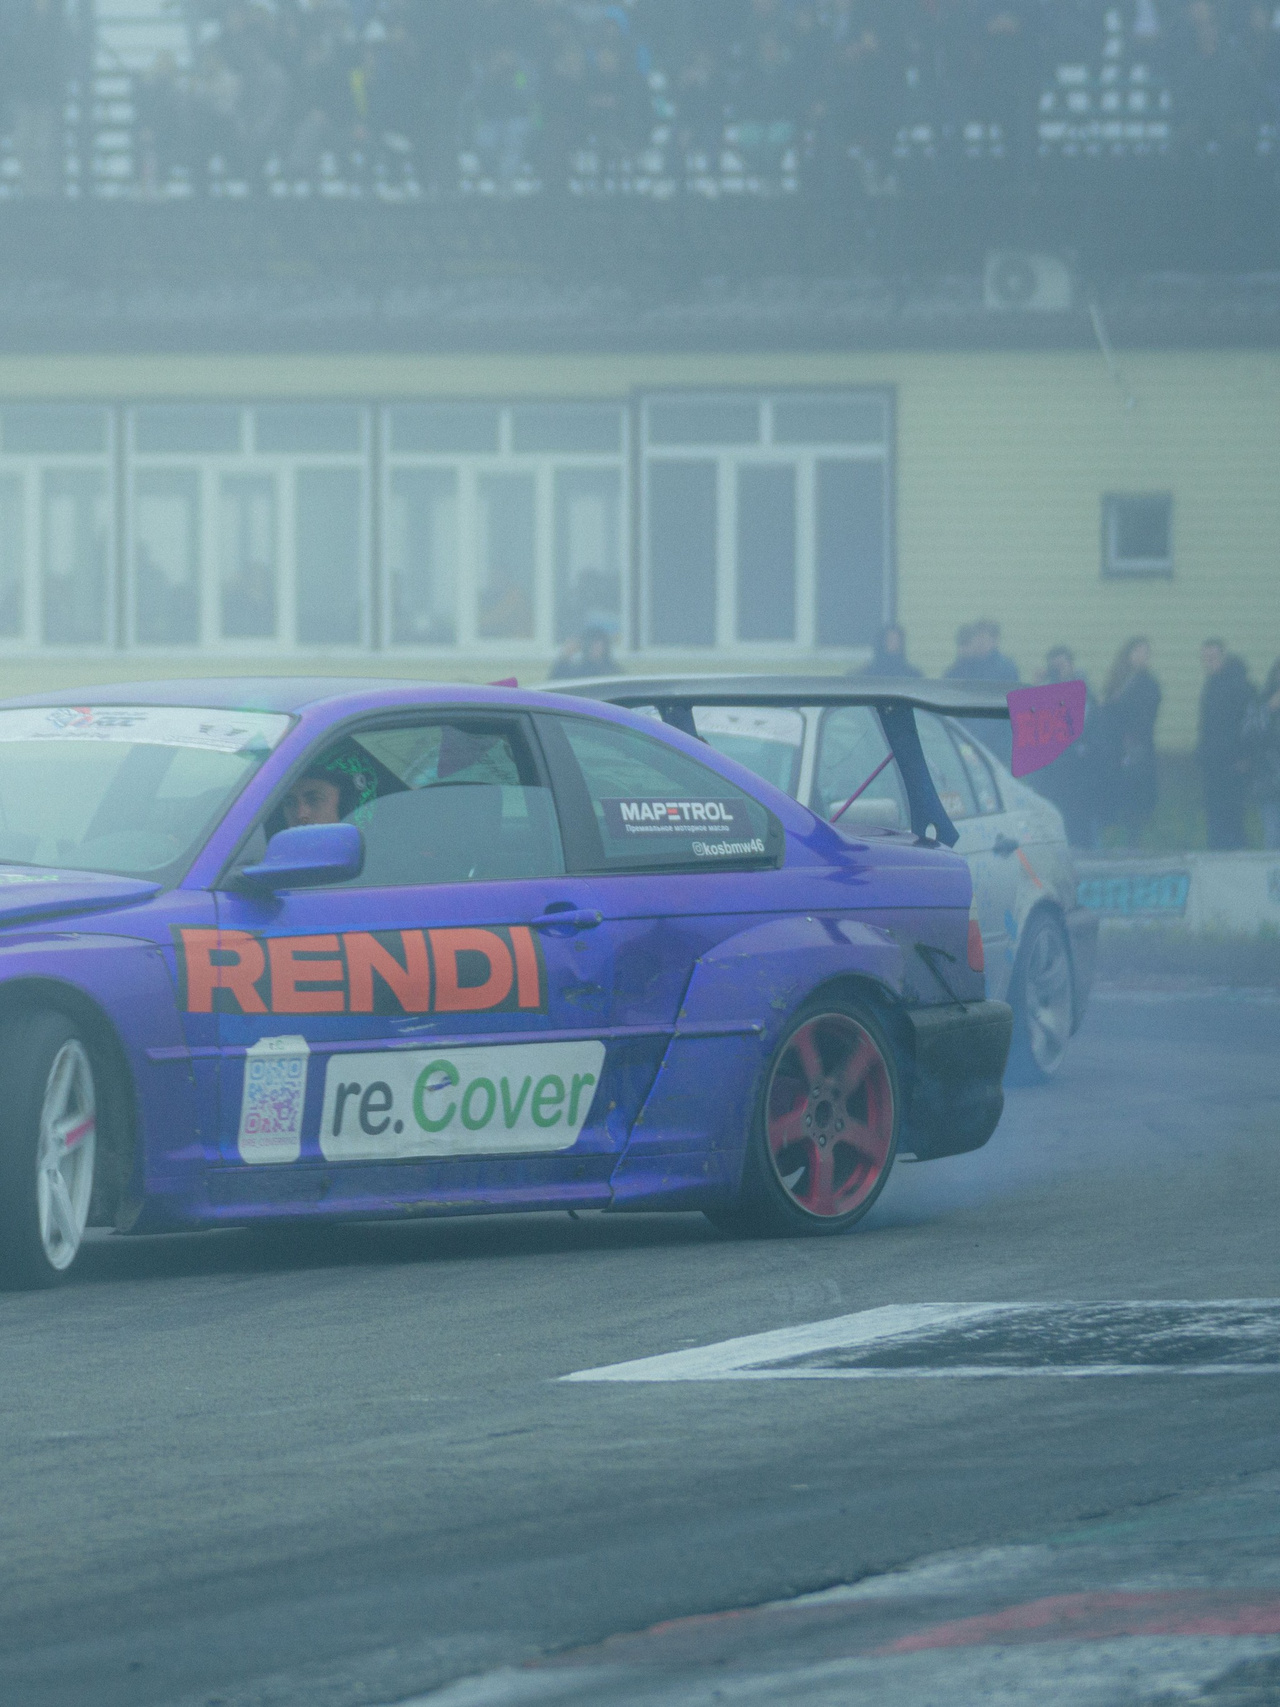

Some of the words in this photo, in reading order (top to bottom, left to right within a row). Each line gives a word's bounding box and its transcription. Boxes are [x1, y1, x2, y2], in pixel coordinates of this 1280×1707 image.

[620, 802, 734, 821] MAPETROL
[625, 823, 673, 834] Премиальное
[675, 824, 707, 833] моторное
[709, 824, 730, 832] масло
[180, 926, 540, 1013] RENDI
[331, 1058, 596, 1137] re.Cover
